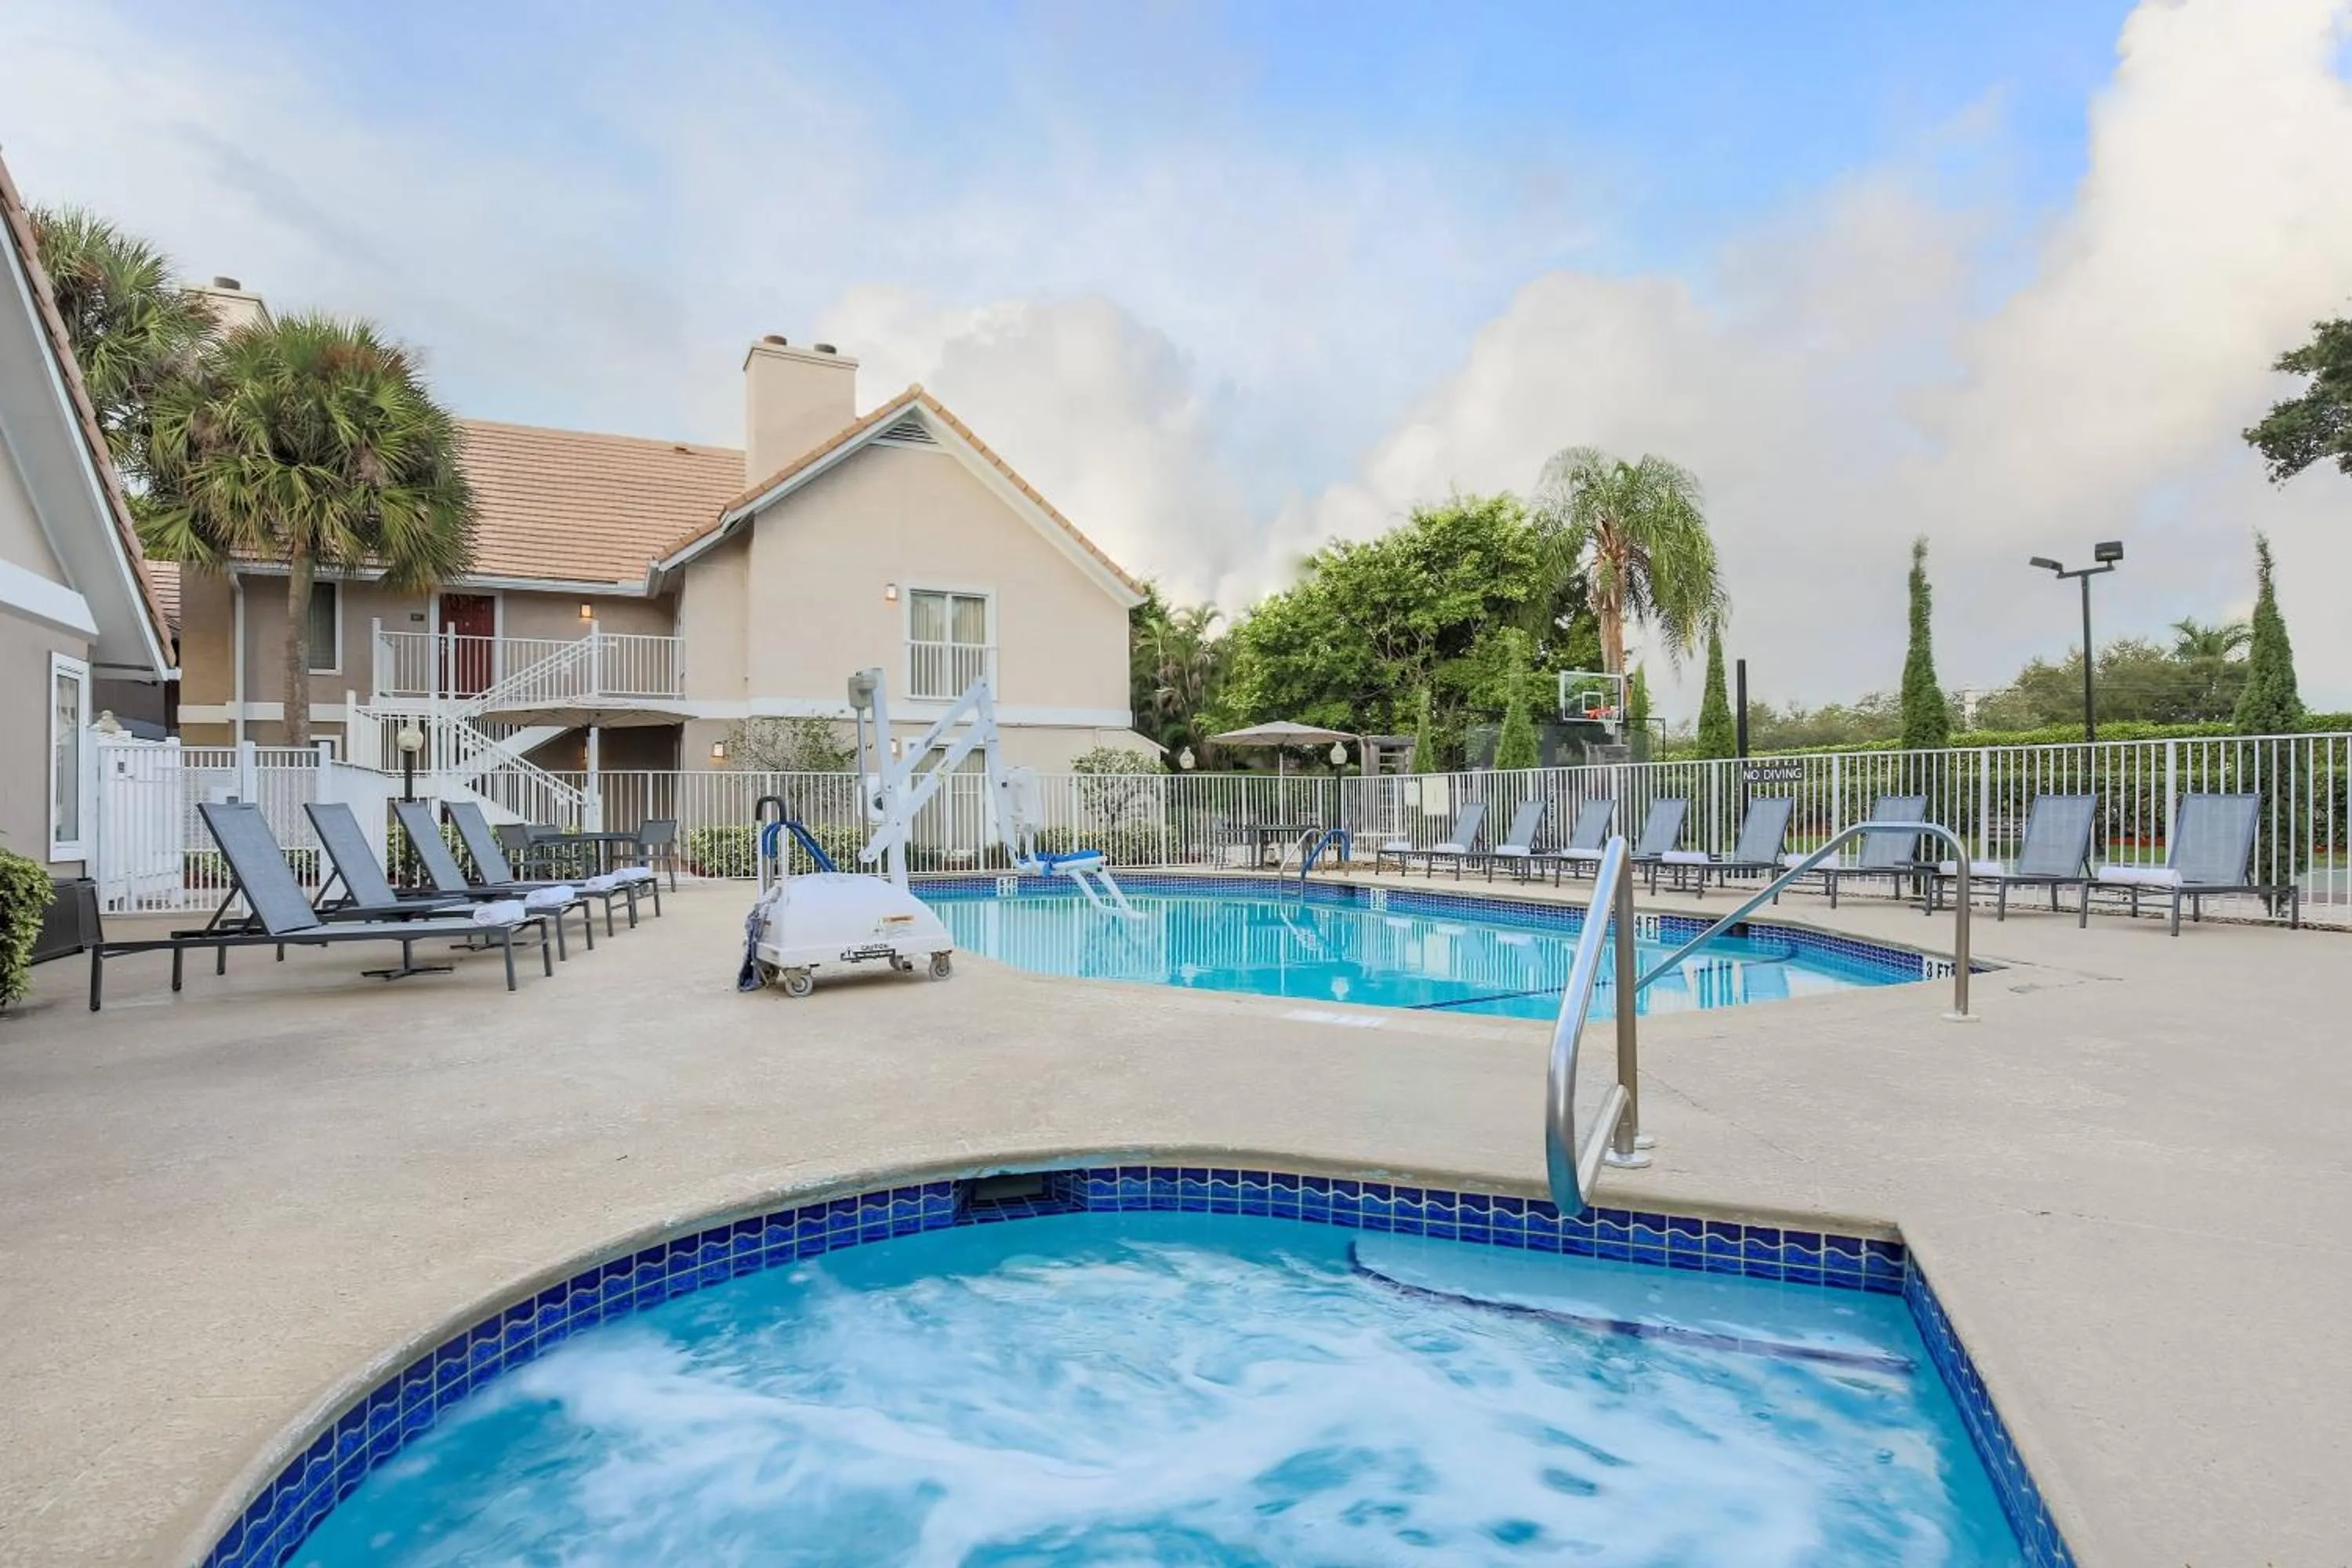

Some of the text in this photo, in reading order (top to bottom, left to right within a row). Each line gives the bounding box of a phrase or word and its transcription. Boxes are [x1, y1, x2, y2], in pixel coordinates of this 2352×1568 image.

[1743, 768, 1802, 780] NO DIVING
[1646, 916, 1658, 928] FT
[1926, 960, 1950, 979] 3 FT
